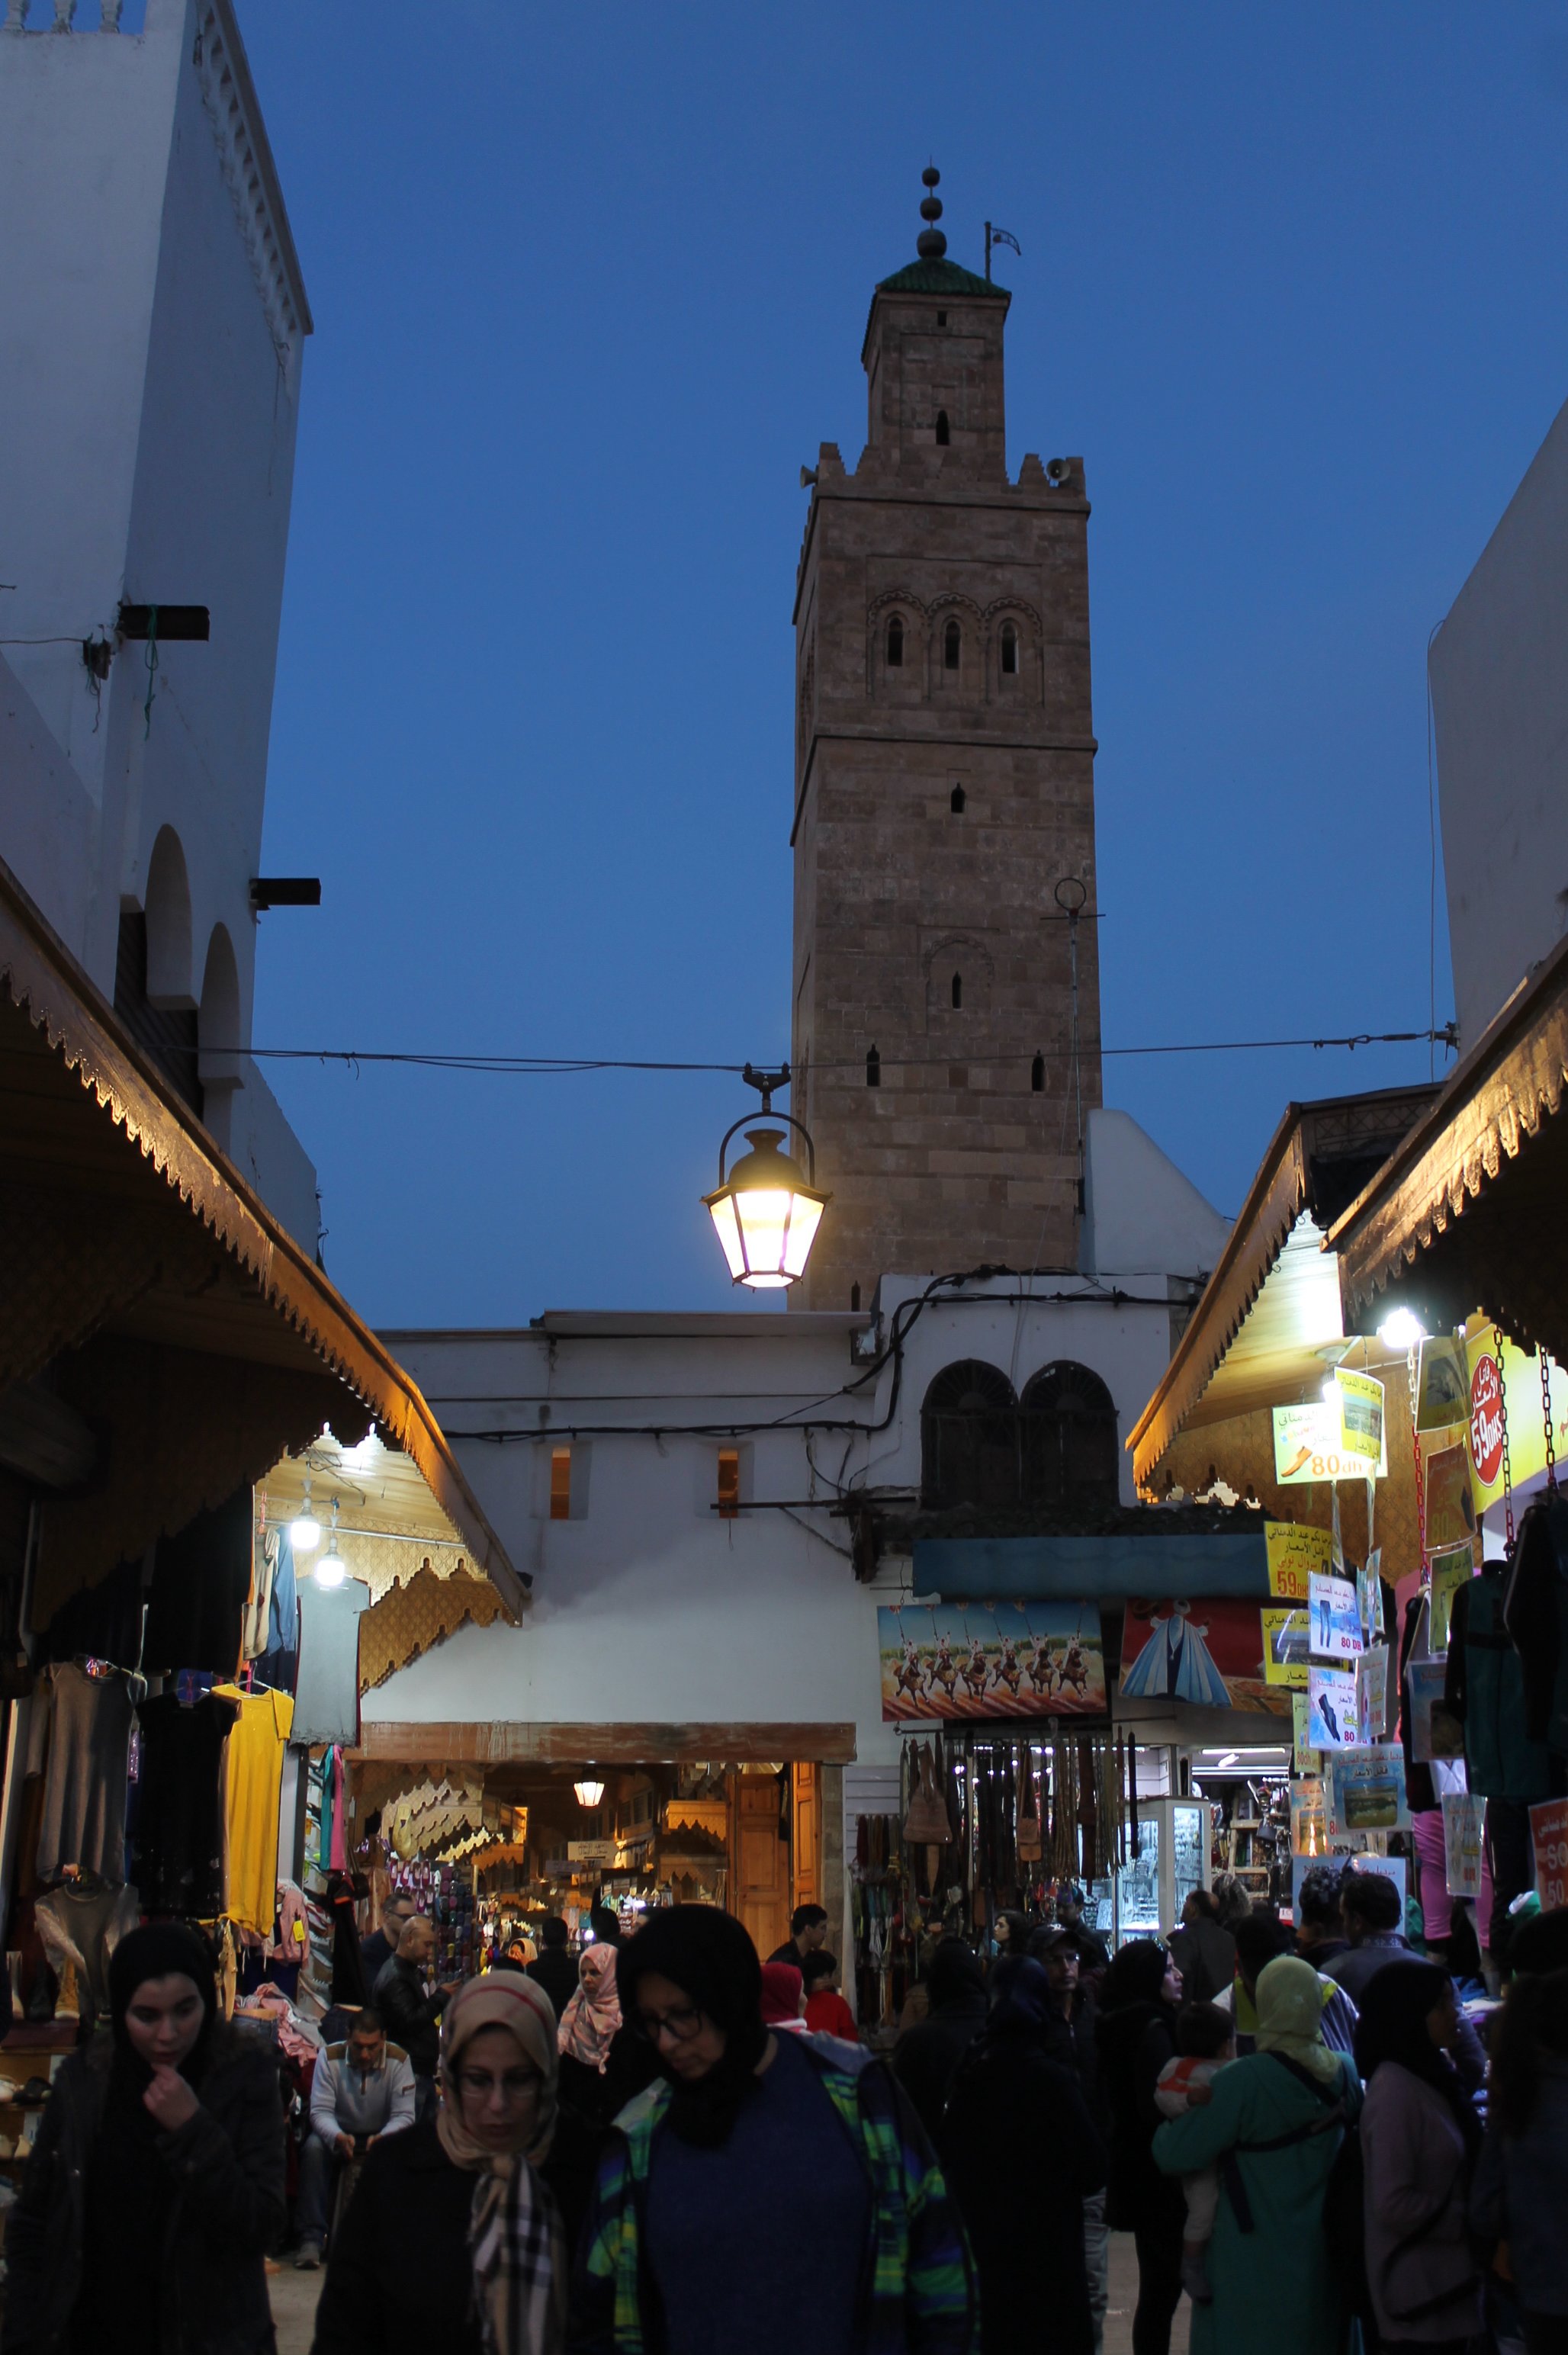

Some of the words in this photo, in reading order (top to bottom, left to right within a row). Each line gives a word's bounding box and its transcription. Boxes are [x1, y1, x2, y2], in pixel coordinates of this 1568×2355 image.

[1277, 1570, 1309, 1597] 59DH
[1341, 1637, 1351, 1648] 80
[1344, 1730, 1355, 1743] 80
